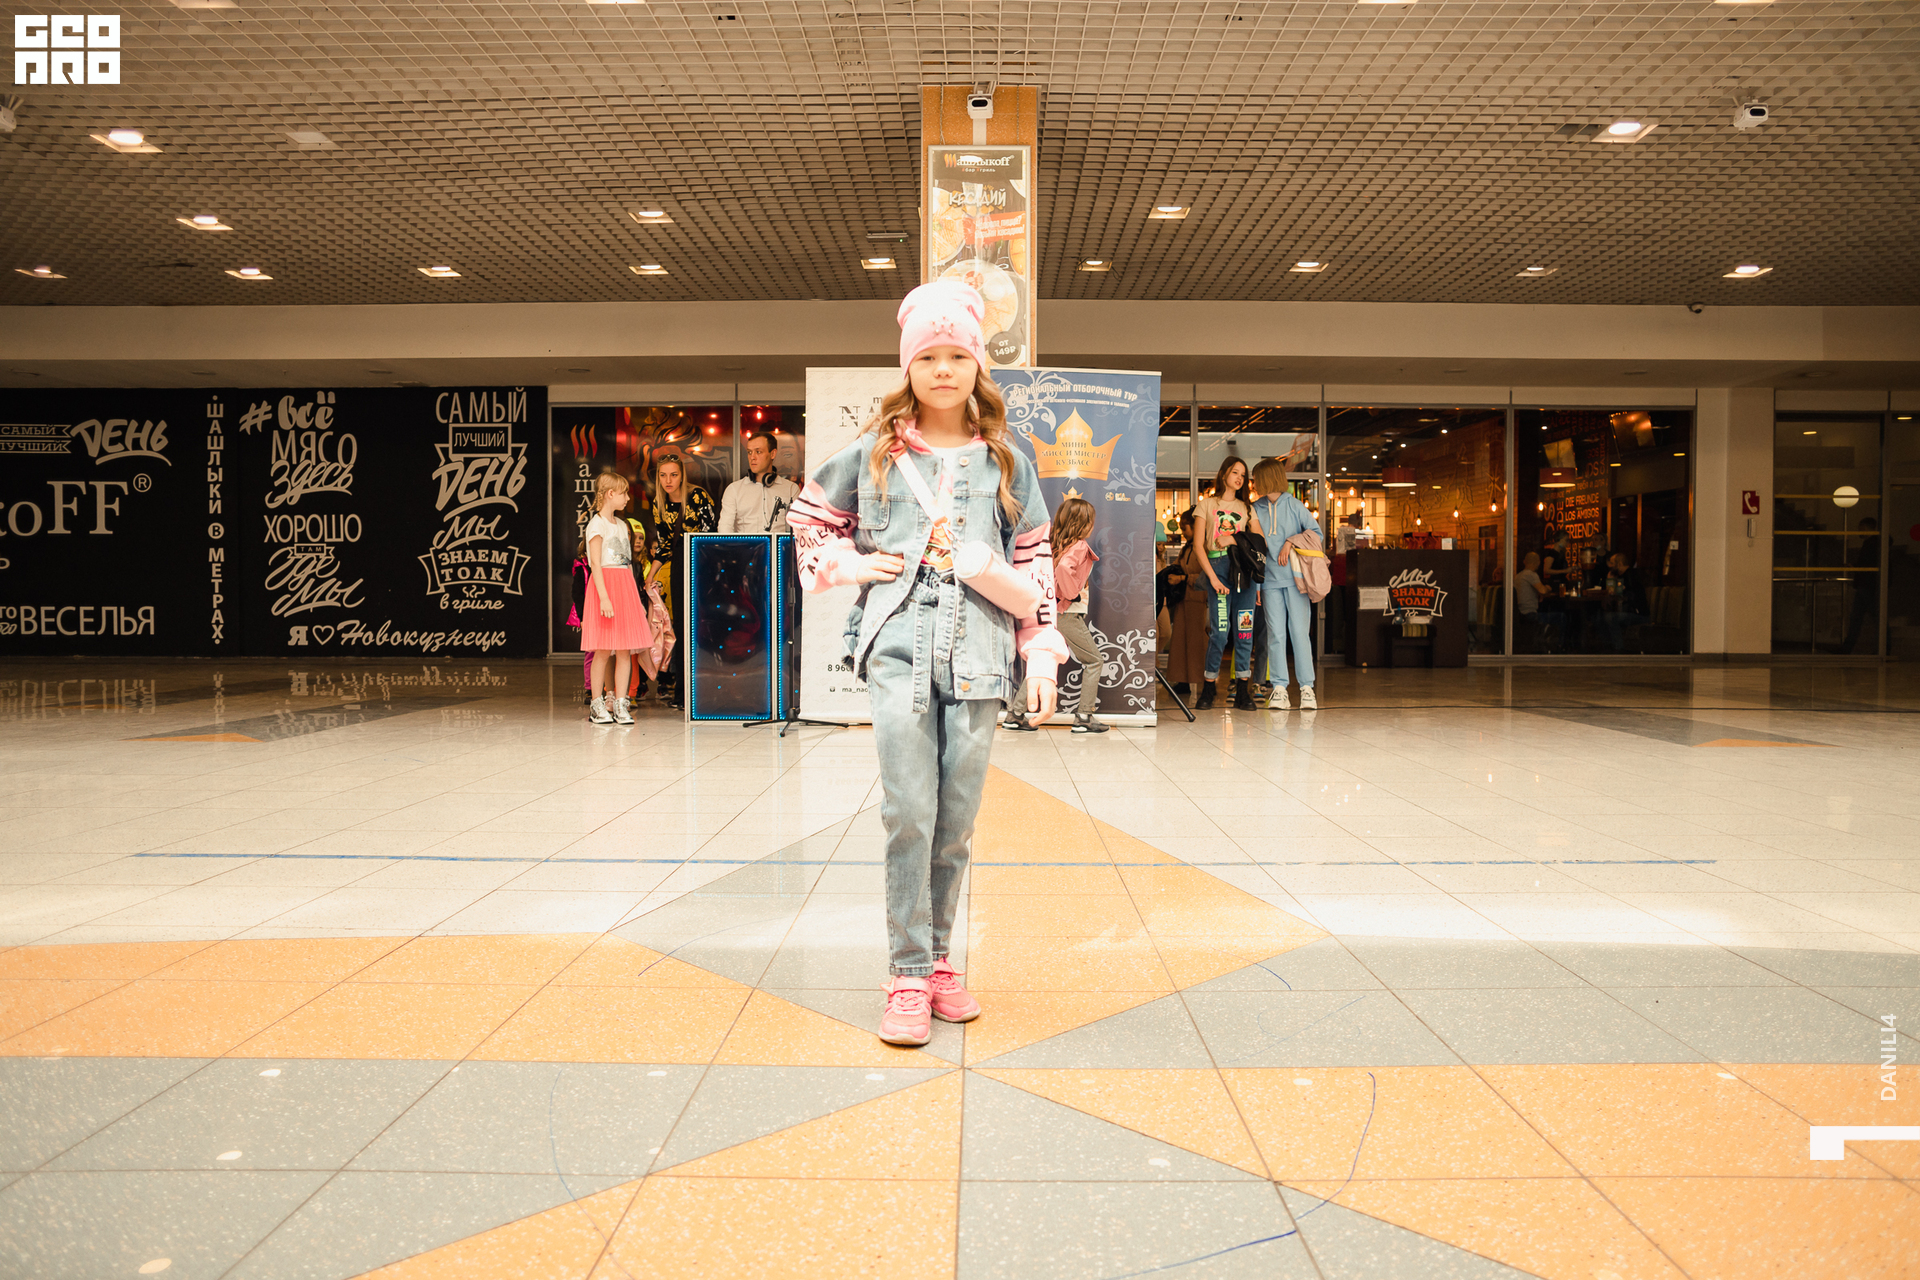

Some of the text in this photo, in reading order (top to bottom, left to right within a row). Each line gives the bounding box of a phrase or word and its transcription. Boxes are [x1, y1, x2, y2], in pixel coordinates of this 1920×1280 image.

[1012, 384, 1138, 401] РЕГИОНАЛЬНЫЙ ОТБОРОЧНЫЙ ТУР
[436, 387, 527, 423] САМЫЙ
[1, 424, 56, 435] САМЫЙ
[454, 430, 505, 447] ЛУЧШИЙ
[271, 430, 357, 468] МЯСО
[1074, 450, 1107, 459] МИСТЕР
[207, 403, 224, 514] ШАШЛЫКИ
[1565, 492, 1600, 507] DIE FREUNDE
[1565, 507, 1600, 521] LOS AMIGOS
[264, 514, 362, 543] ХОРОШО
[1565, 521, 1600, 539] FRIENDS
[438, 550, 508, 566] ЗНАЕМ
[441, 567, 504, 582] ТОЛК
[208, 548, 225, 639] МЕТРАХ
[1391, 587, 1435, 598] ЗНАЕМ
[452, 599, 505, 614] гриле
[1396, 597, 1430, 607] ТОЛК
[20, 605, 155, 636] ВЕСЕЛЬЯ
[288, 620, 507, 653] Я Новокузнецк
[827, 664, 850, 672] 8 96
